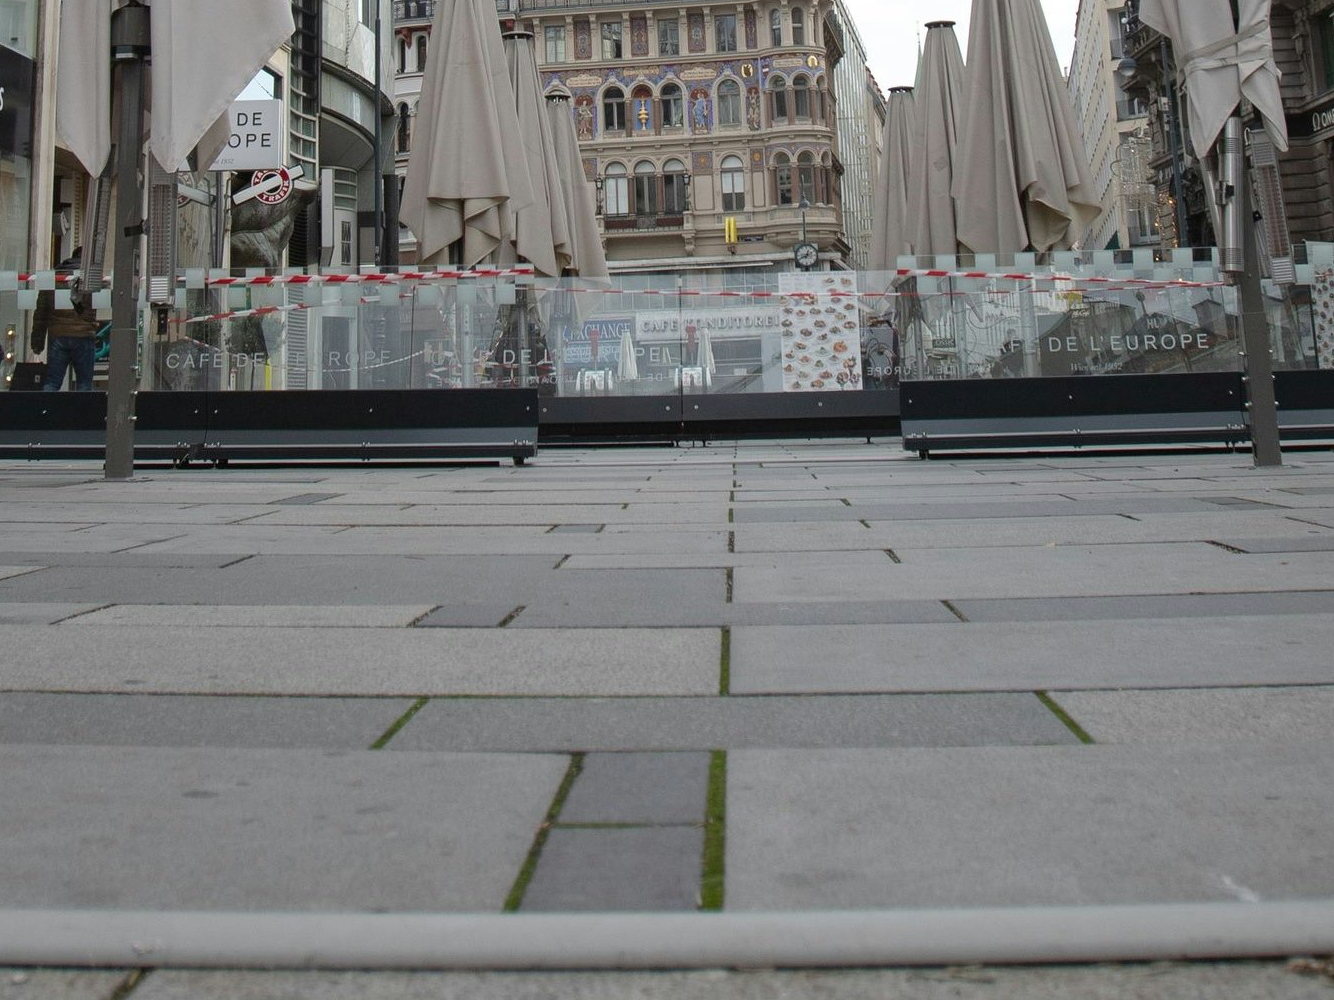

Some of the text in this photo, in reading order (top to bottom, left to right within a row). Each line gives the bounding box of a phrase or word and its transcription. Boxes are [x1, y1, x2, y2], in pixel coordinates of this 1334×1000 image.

[237, 112, 263, 127] DE
[261, 179, 291, 202] TRAFIK
[1049, 334, 1078, 353] DE
[1089, 332, 1210, 353] L'EUROPE
[165, 352, 223, 370] CAFE
[502, 349, 533, 366] DE
